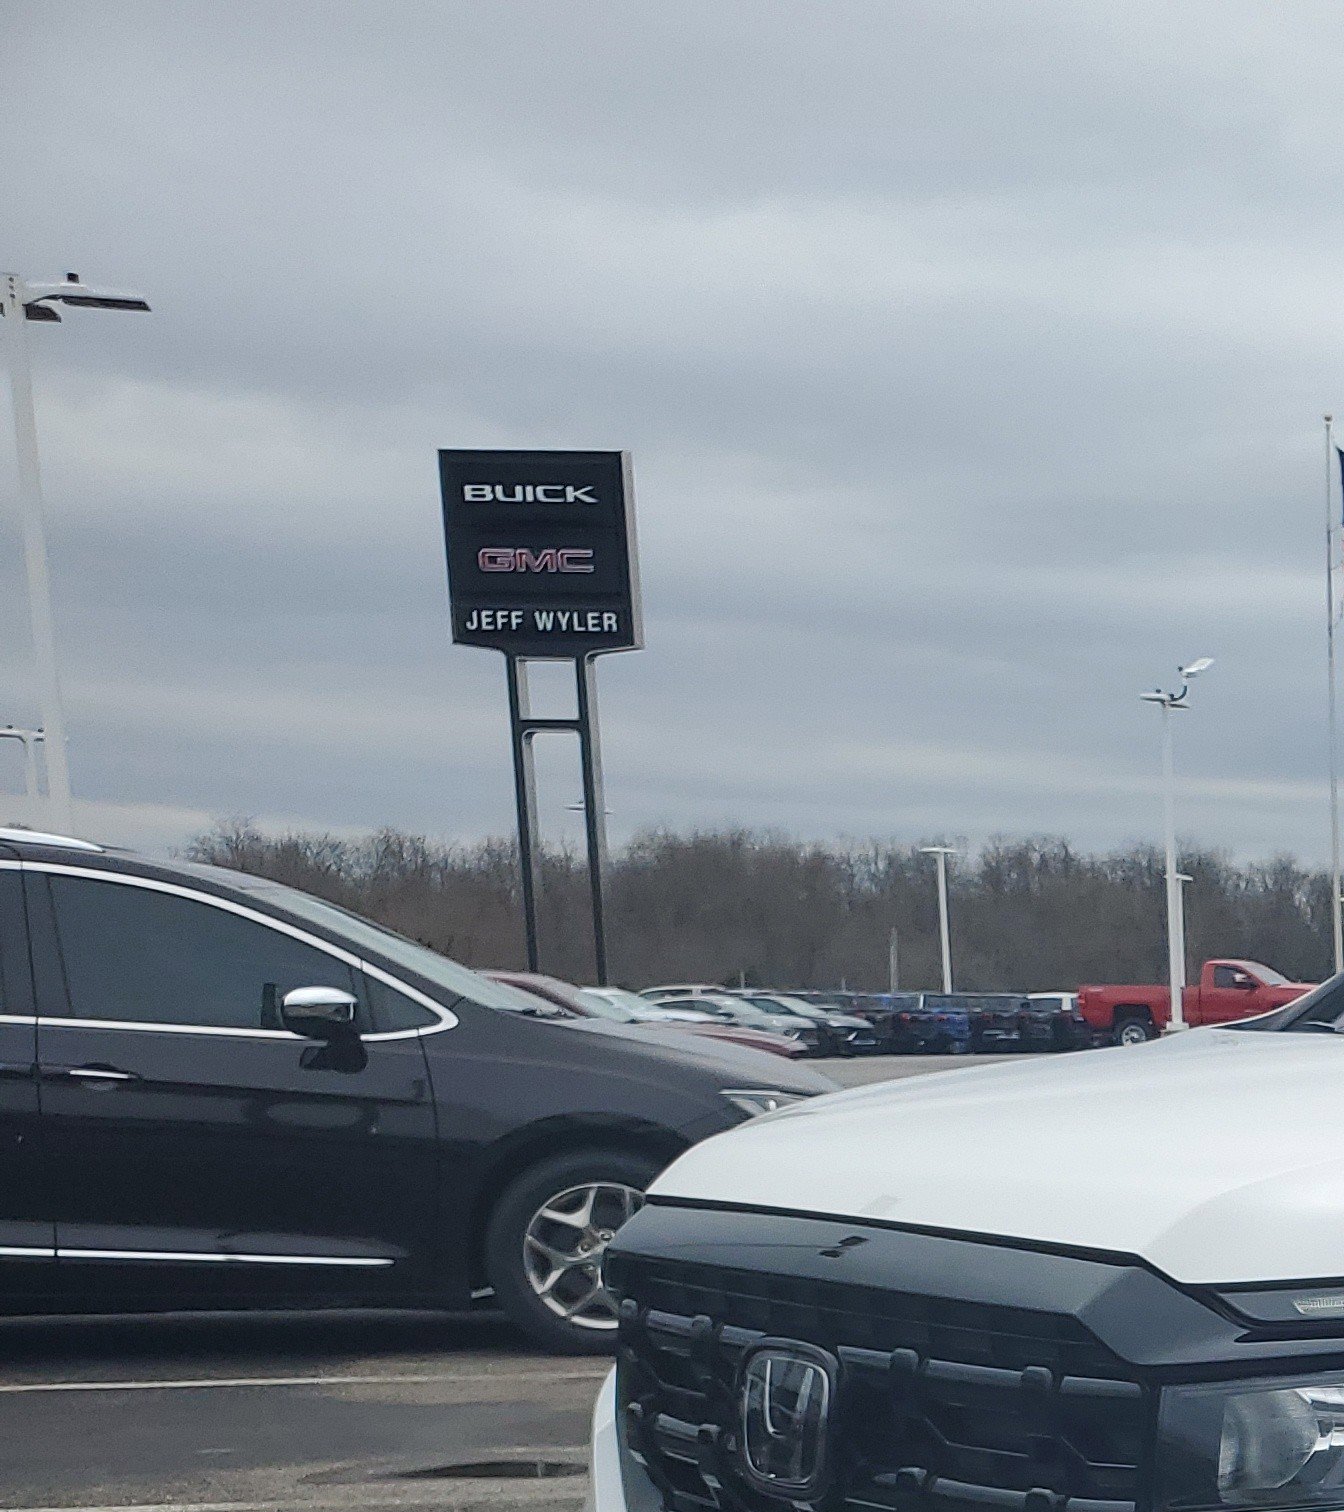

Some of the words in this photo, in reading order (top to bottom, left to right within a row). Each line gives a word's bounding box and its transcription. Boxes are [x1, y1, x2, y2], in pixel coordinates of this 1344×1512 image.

[462, 484, 599, 503] BUICK
[477, 547, 595, 573] GMC
[465, 609, 525, 631] JEFF
[533, 610, 619, 633] WYLER
